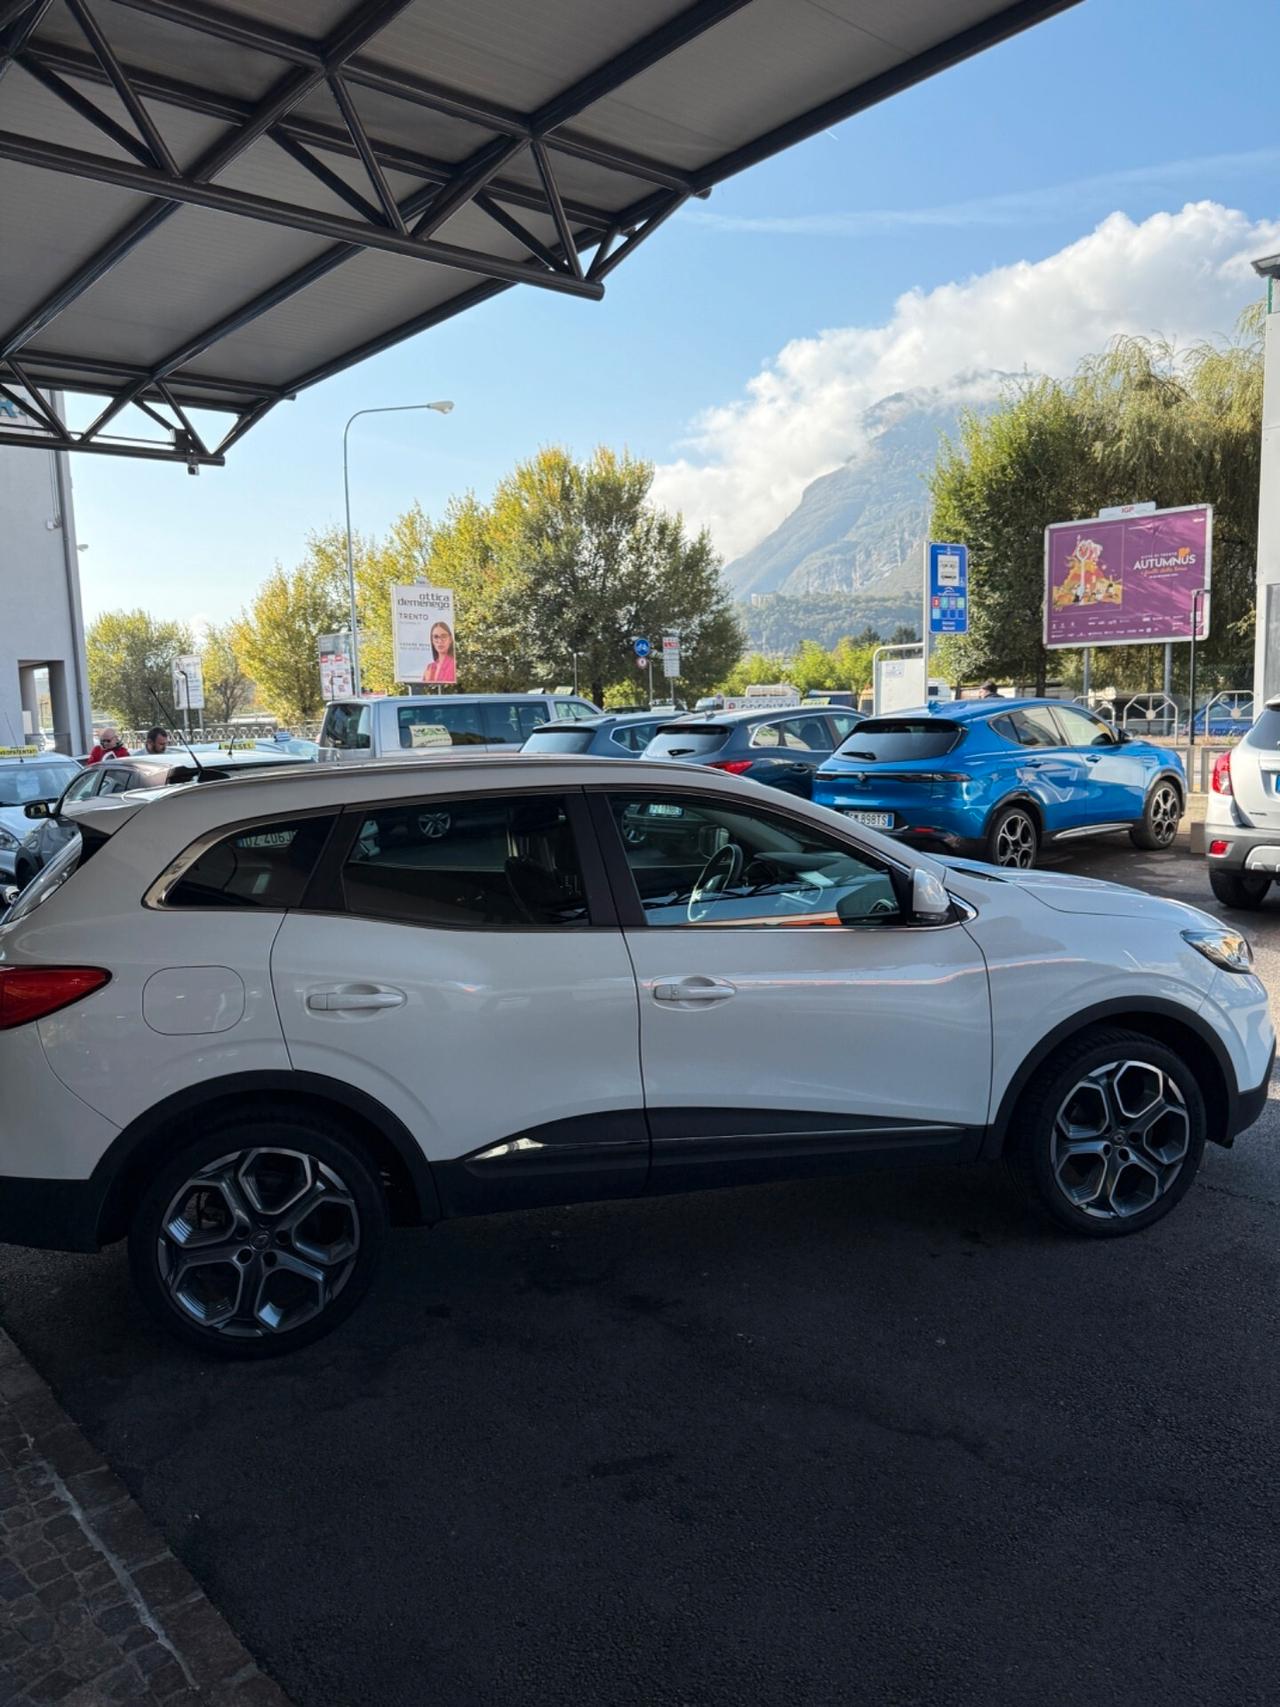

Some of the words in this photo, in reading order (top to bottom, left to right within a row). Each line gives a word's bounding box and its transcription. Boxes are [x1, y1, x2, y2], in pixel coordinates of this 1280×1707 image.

[1133, 554, 1197, 570] AUTUMNUS
[419, 592, 450, 601] ottica
[397, 598, 450, 610] demenego
[399, 613, 429, 621] TRENTO
